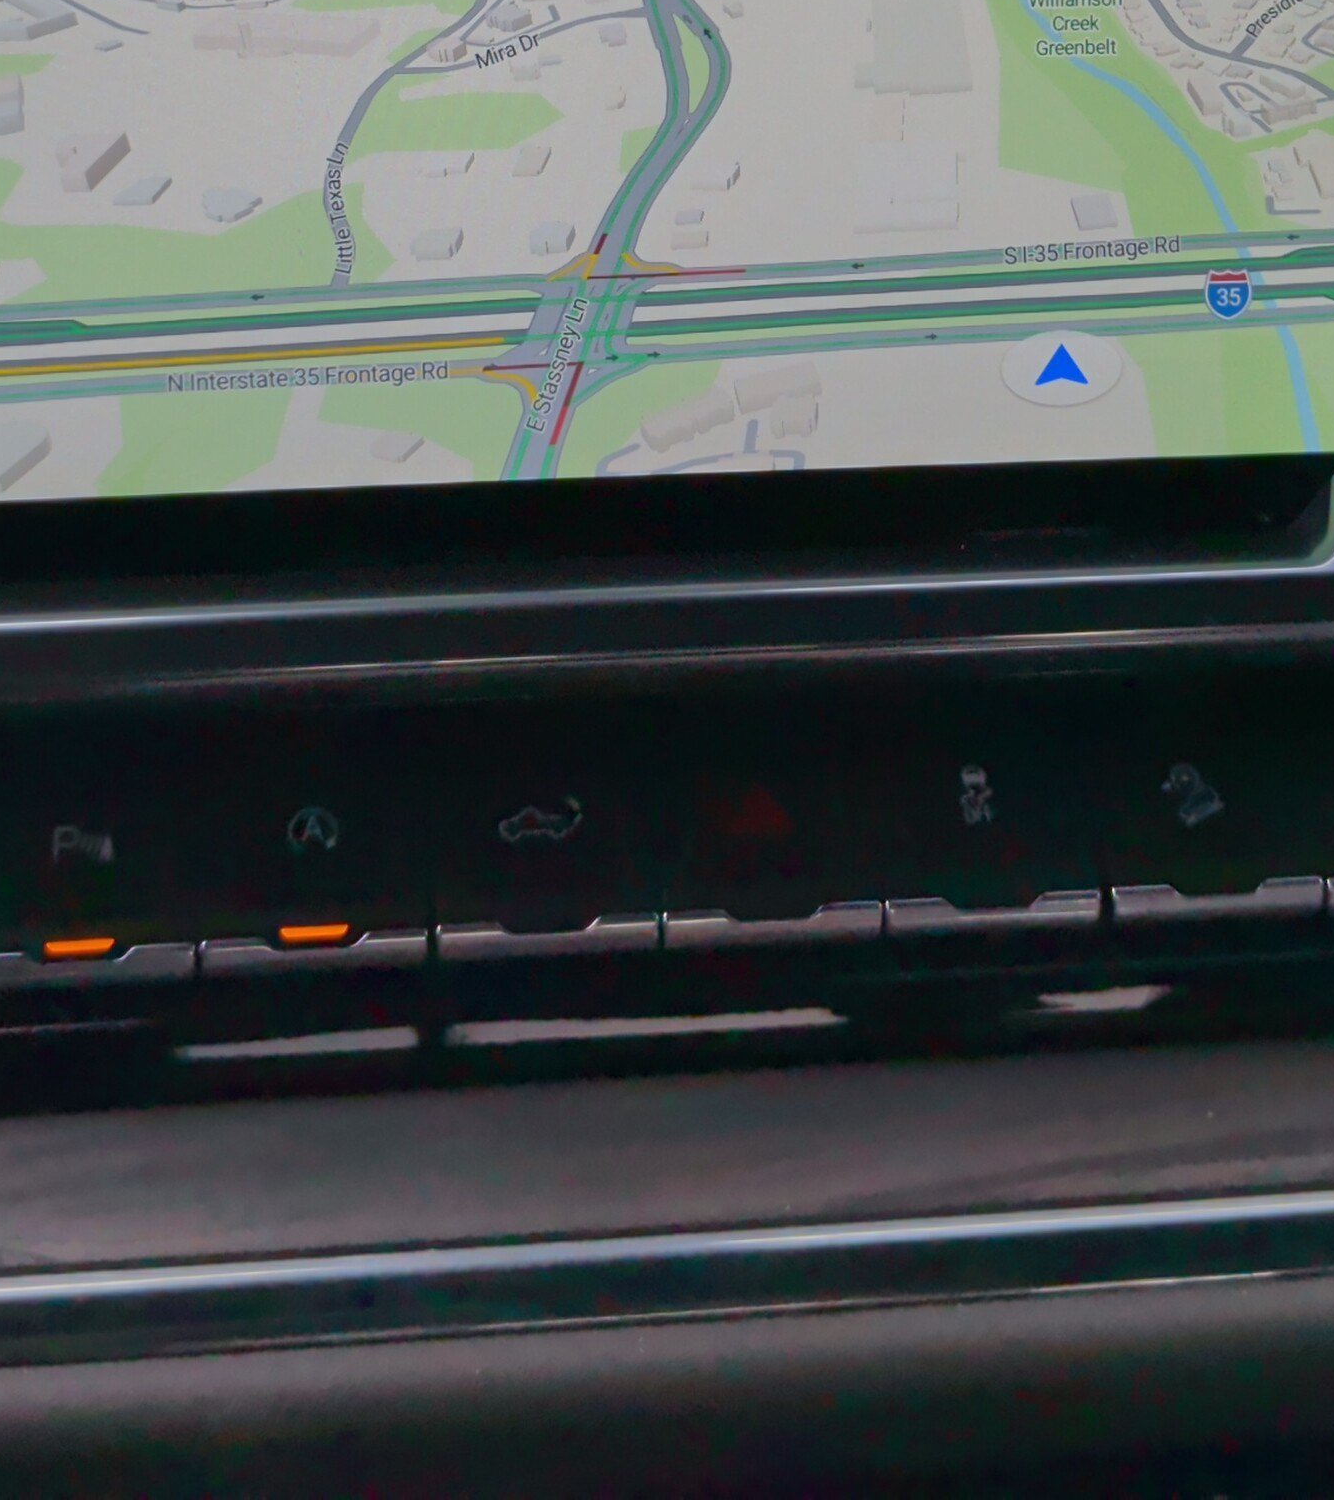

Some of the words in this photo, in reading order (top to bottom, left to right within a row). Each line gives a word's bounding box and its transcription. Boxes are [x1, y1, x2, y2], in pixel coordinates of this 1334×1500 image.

[1052, 15, 1099, 31] Creek
[474, 44, 517, 69] Mira
[518, 33, 539, 52] Dr
[1036, 38, 1117, 56] Greenbelt
[326, 141, 350, 166] Ln
[328, 168, 347, 226] Texas
[334, 228, 353, 275] Little
[1004, 246, 1018, 266] S
[1022, 243, 1060, 264] I-35
[1063, 238, 1150, 261] Frontage
[1155, 235, 1181, 255] Rd
[565, 298, 588, 323] Ln
[1216, 286, 1242, 308] 35
[168, 374, 184, 393] N
[189, 370, 289, 392] Interstate
[294, 367, 321, 387] 35
[325, 364, 417, 388] Frontage
[421, 361, 449, 380] Rd
[533, 325, 581, 414] Stassney
[526, 416, 546, 432] E
